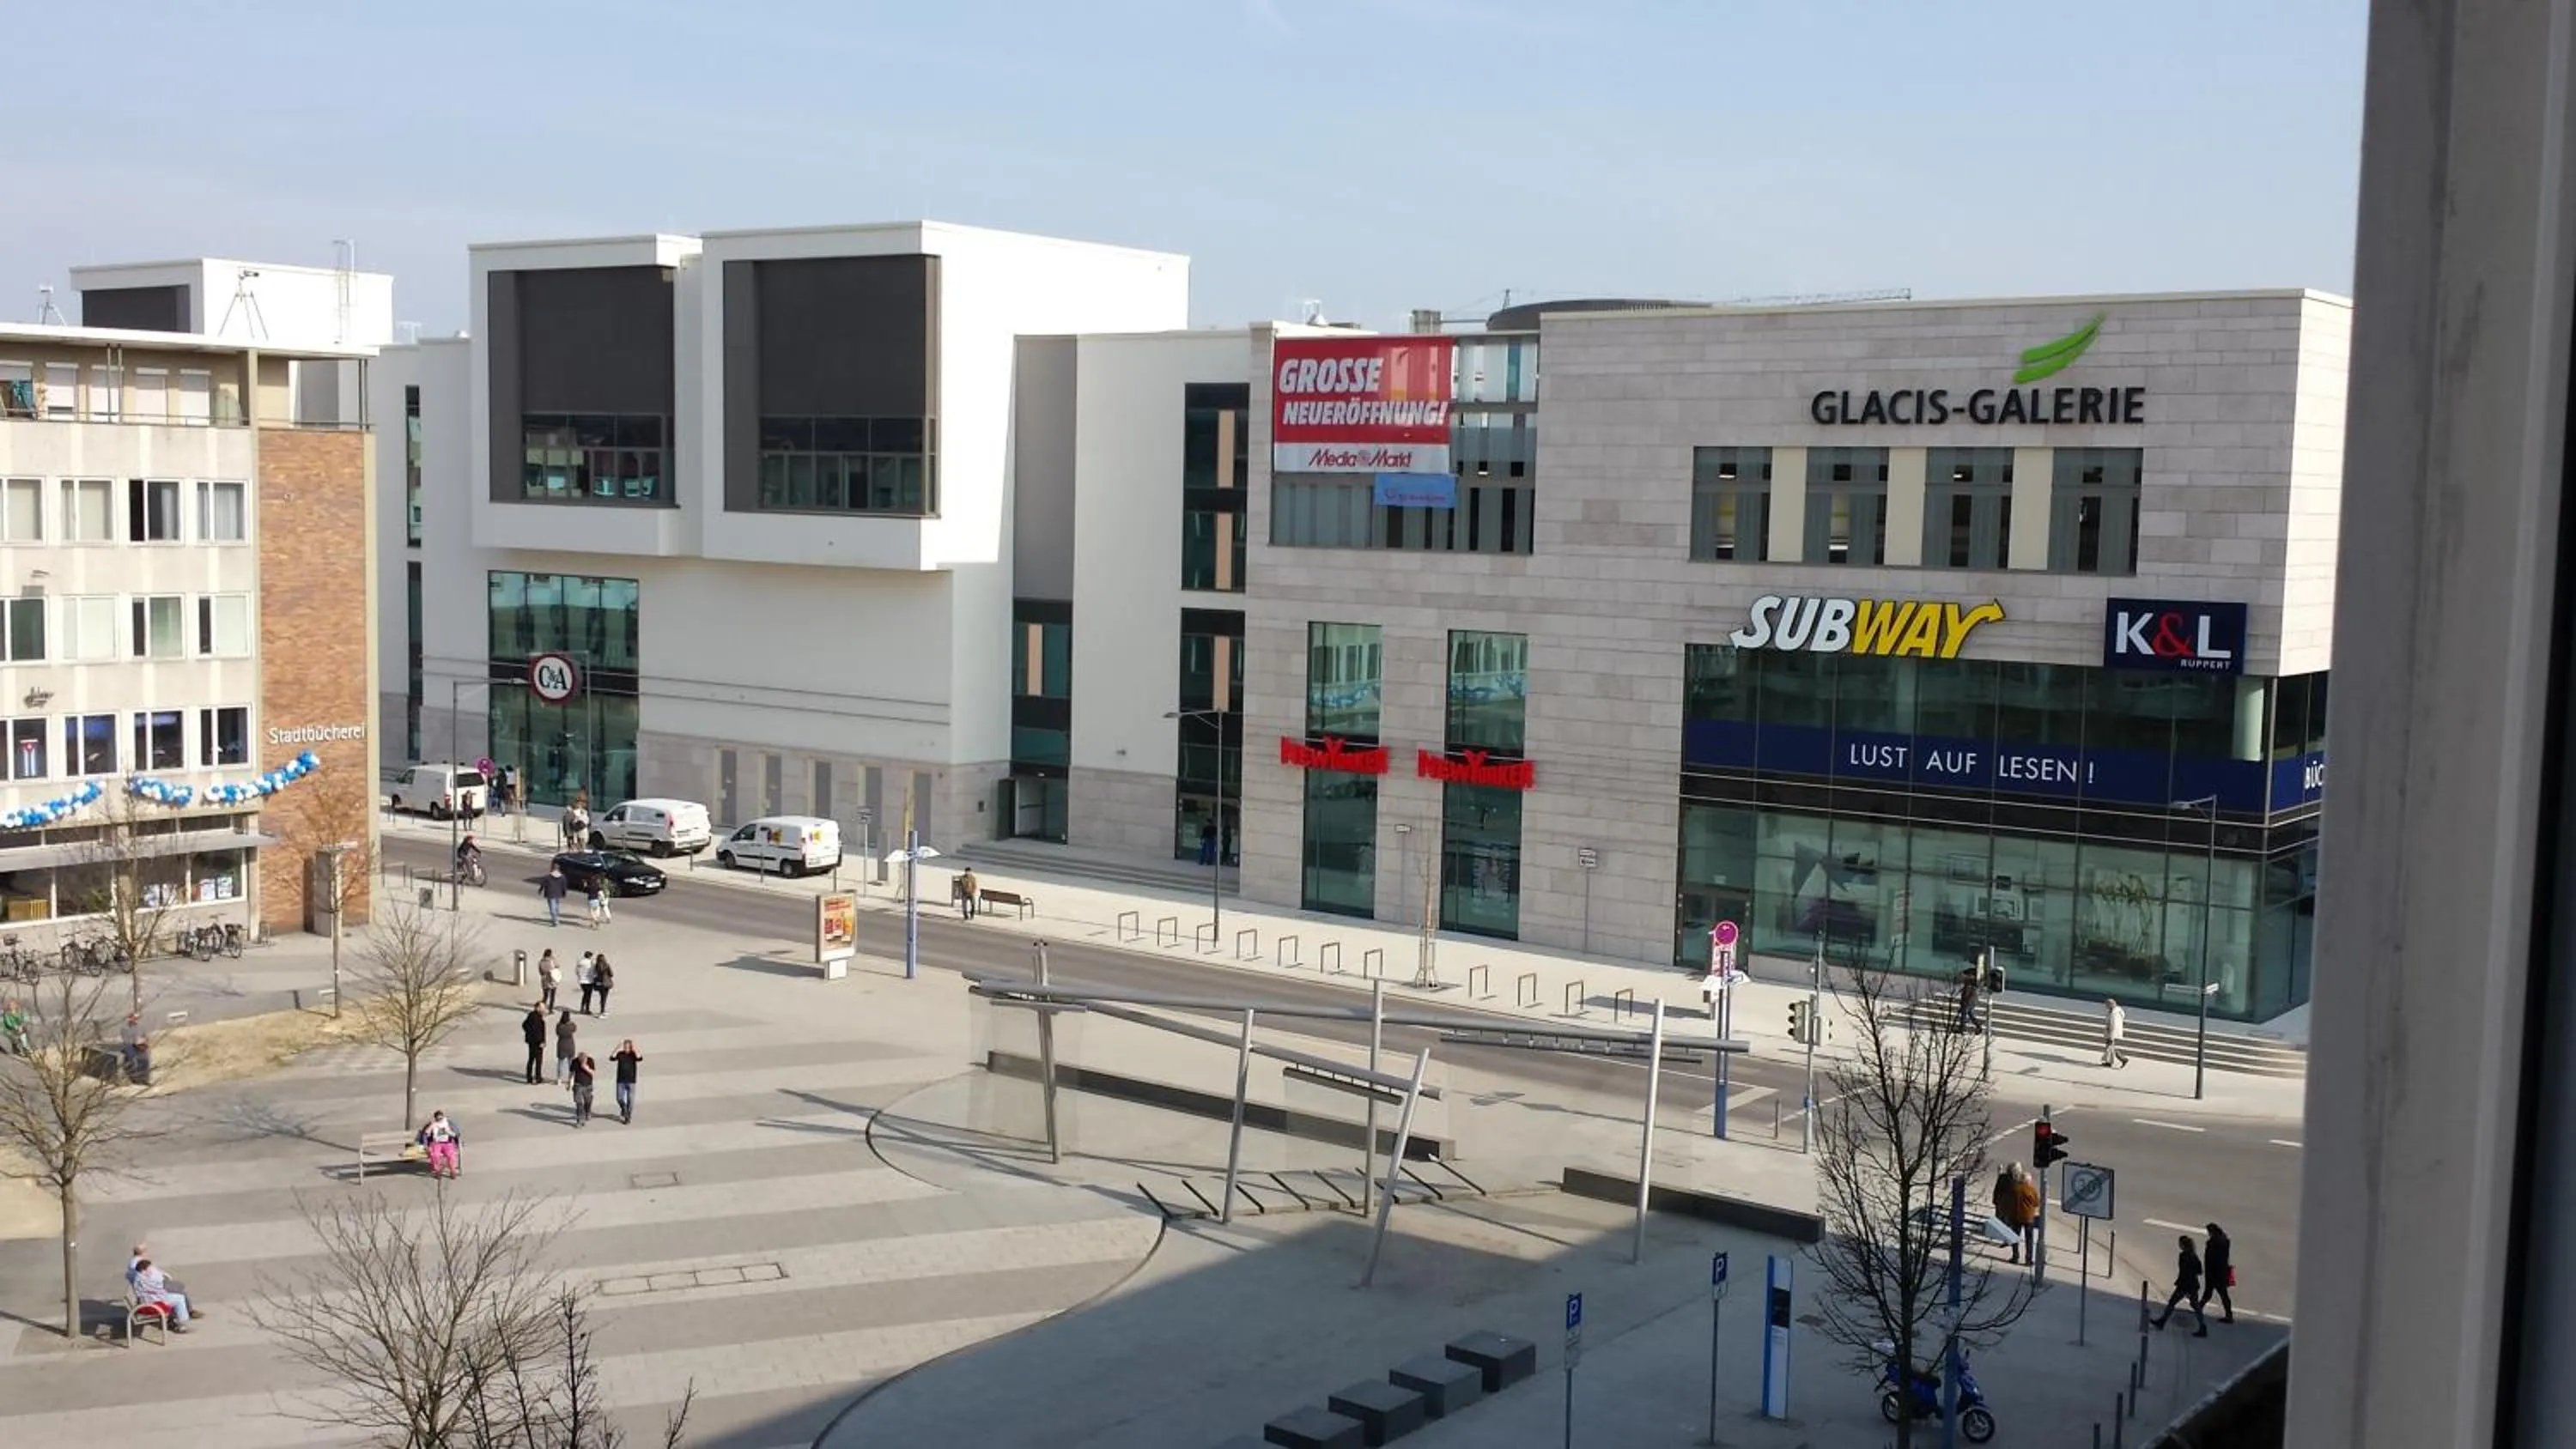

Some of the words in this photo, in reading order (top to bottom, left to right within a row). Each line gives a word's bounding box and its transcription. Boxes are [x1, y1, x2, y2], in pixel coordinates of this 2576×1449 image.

[1279, 356, 1384, 394] GROSSE
[1282, 397, 1449, 427] NEUERÖFFNUNG!
[1811, 387, 2146, 426] GLACIS-GALERIE
[1729, 594, 2006, 658] SUBWAY
[2115, 611, 2232, 659] K&L
[538, 665, 568, 691] C&A
[2180, 658, 2233, 670] RUPPERT
[269, 723, 366, 744] Stadtbücherei
[1850, 743, 1908, 768] LUST
[1926, 749, 1977, 773] AUF
[1715, 1258, 1725, 1281] P
[1569, 1299, 1579, 1325] P
